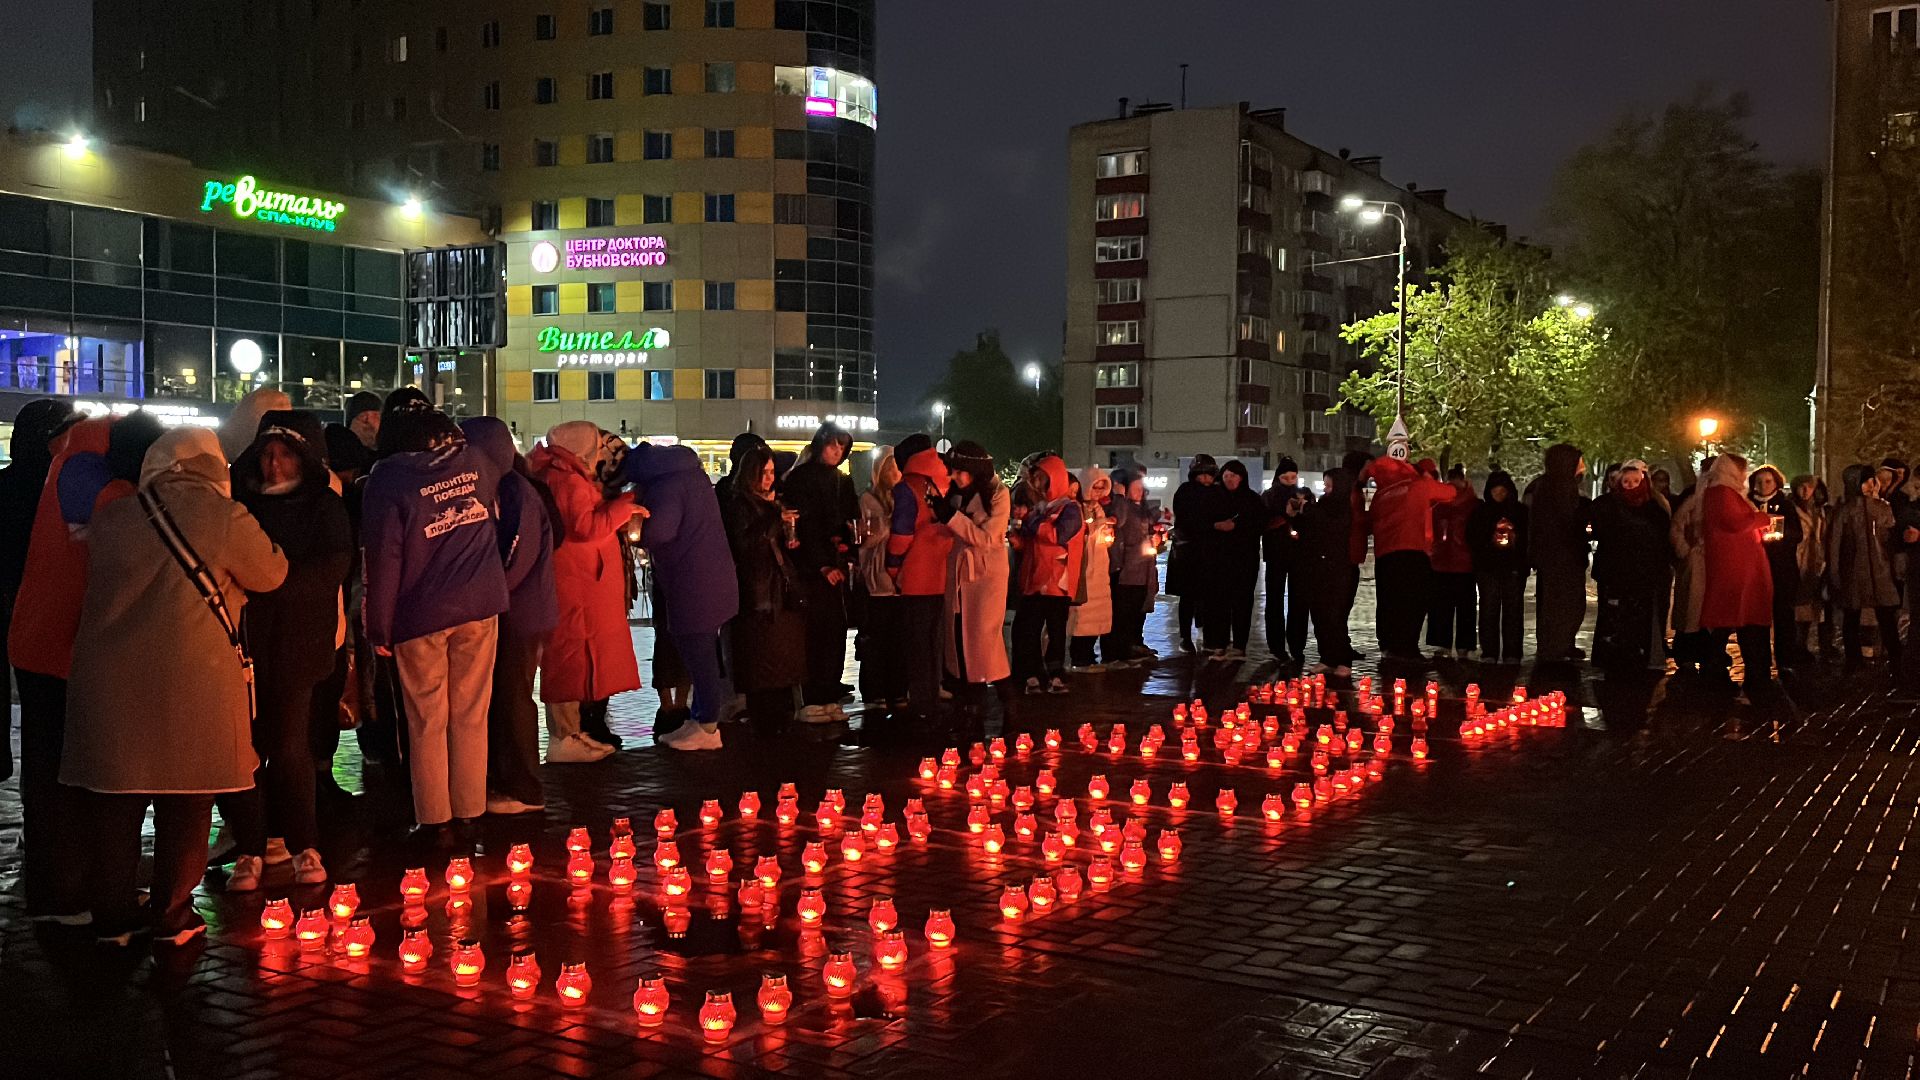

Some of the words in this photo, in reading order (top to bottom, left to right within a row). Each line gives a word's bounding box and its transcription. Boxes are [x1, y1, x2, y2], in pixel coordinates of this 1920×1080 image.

[257, 209, 336, 232] СПА-КЛУБ
[565, 238, 606, 253] ЦЕНТР
[607, 236, 665, 253] ДОКТОРА
[566, 251, 666, 268] БУБНОВСКОГО
[557, 351, 648, 367] ресторан
[777, 415, 822, 429] HOTEL
[1391, 447, 1405, 458] 40
[433, 482, 476, 504] ПОБЕДЫ
